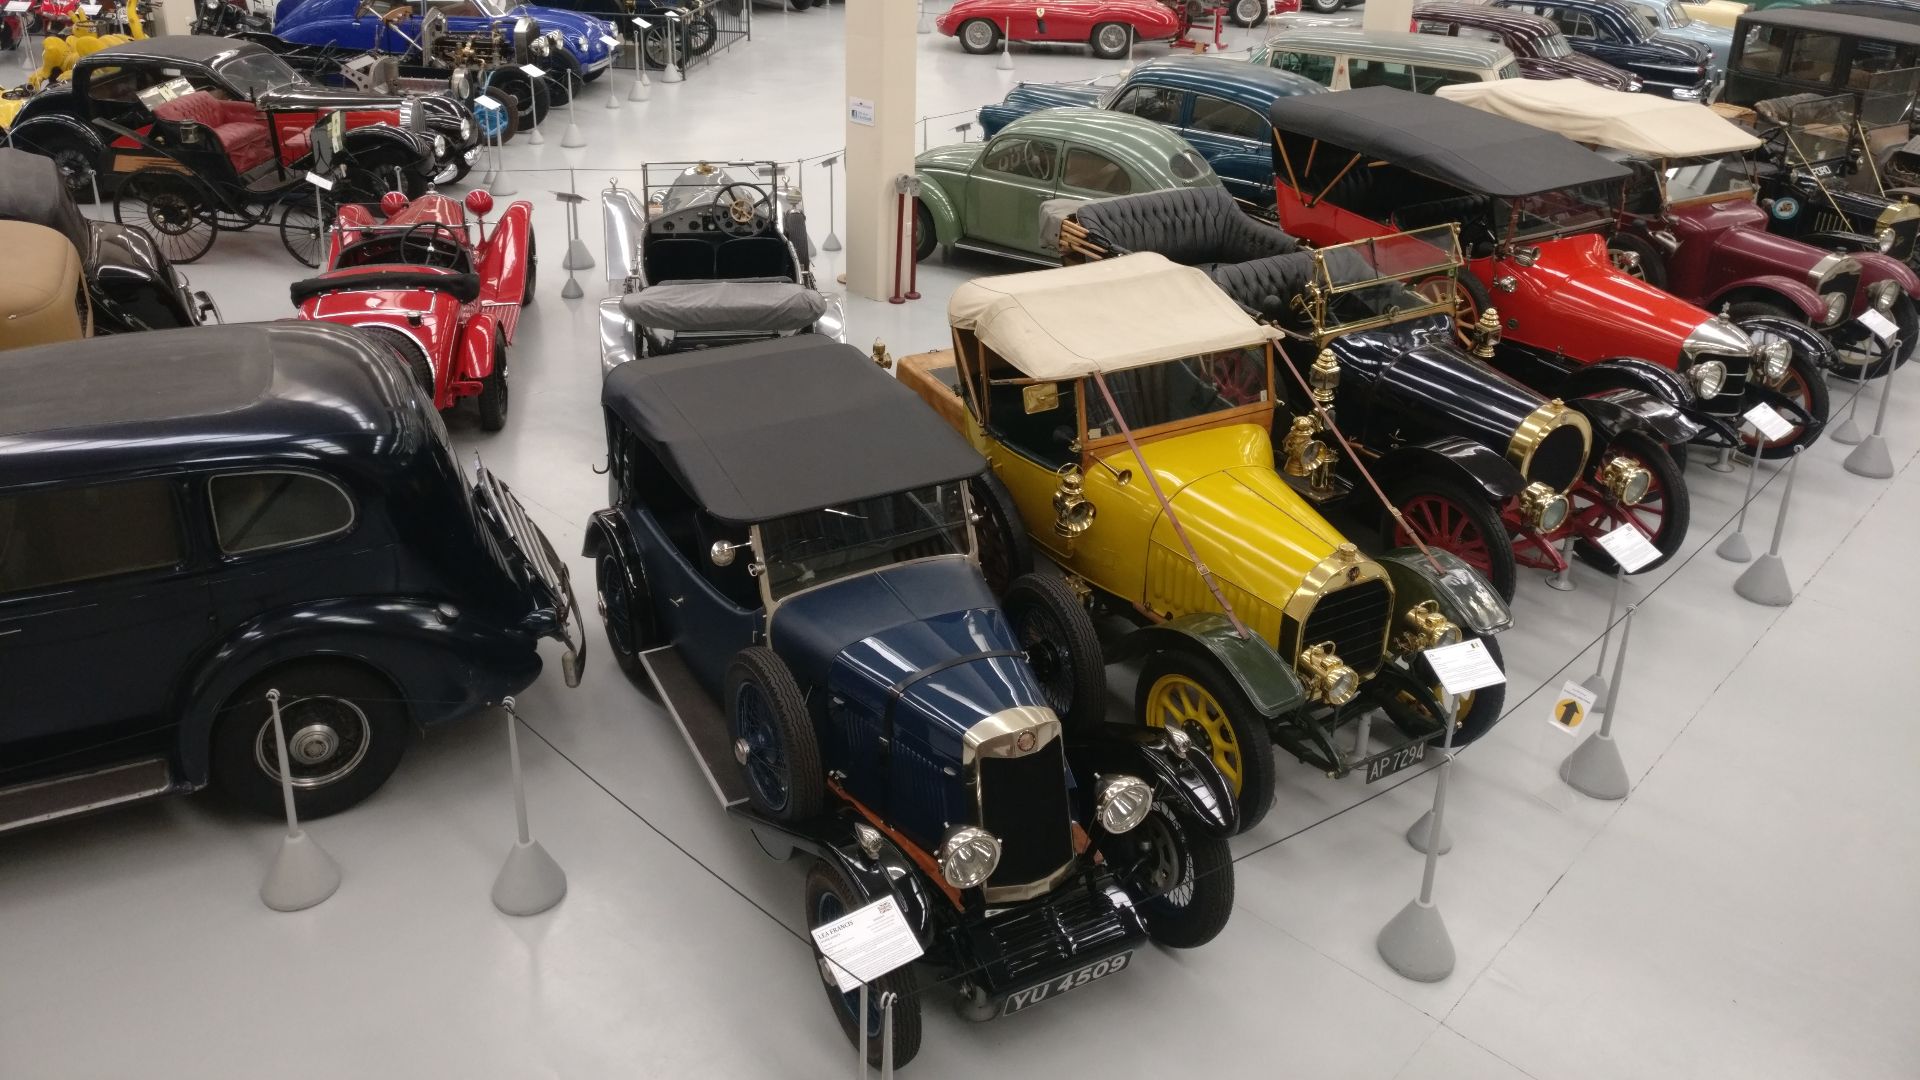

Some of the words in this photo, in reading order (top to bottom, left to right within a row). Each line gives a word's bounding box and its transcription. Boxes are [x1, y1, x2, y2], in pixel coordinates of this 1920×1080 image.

[1369, 757, 1390, 780] AP
[1393, 741, 1425, 770] 7294
[817, 931, 830, 940] LEA
[829, 920, 855, 935] FRANCIS
[1014, 983, 1050, 1010] YU
[1057, 955, 1127, 992] 4509
